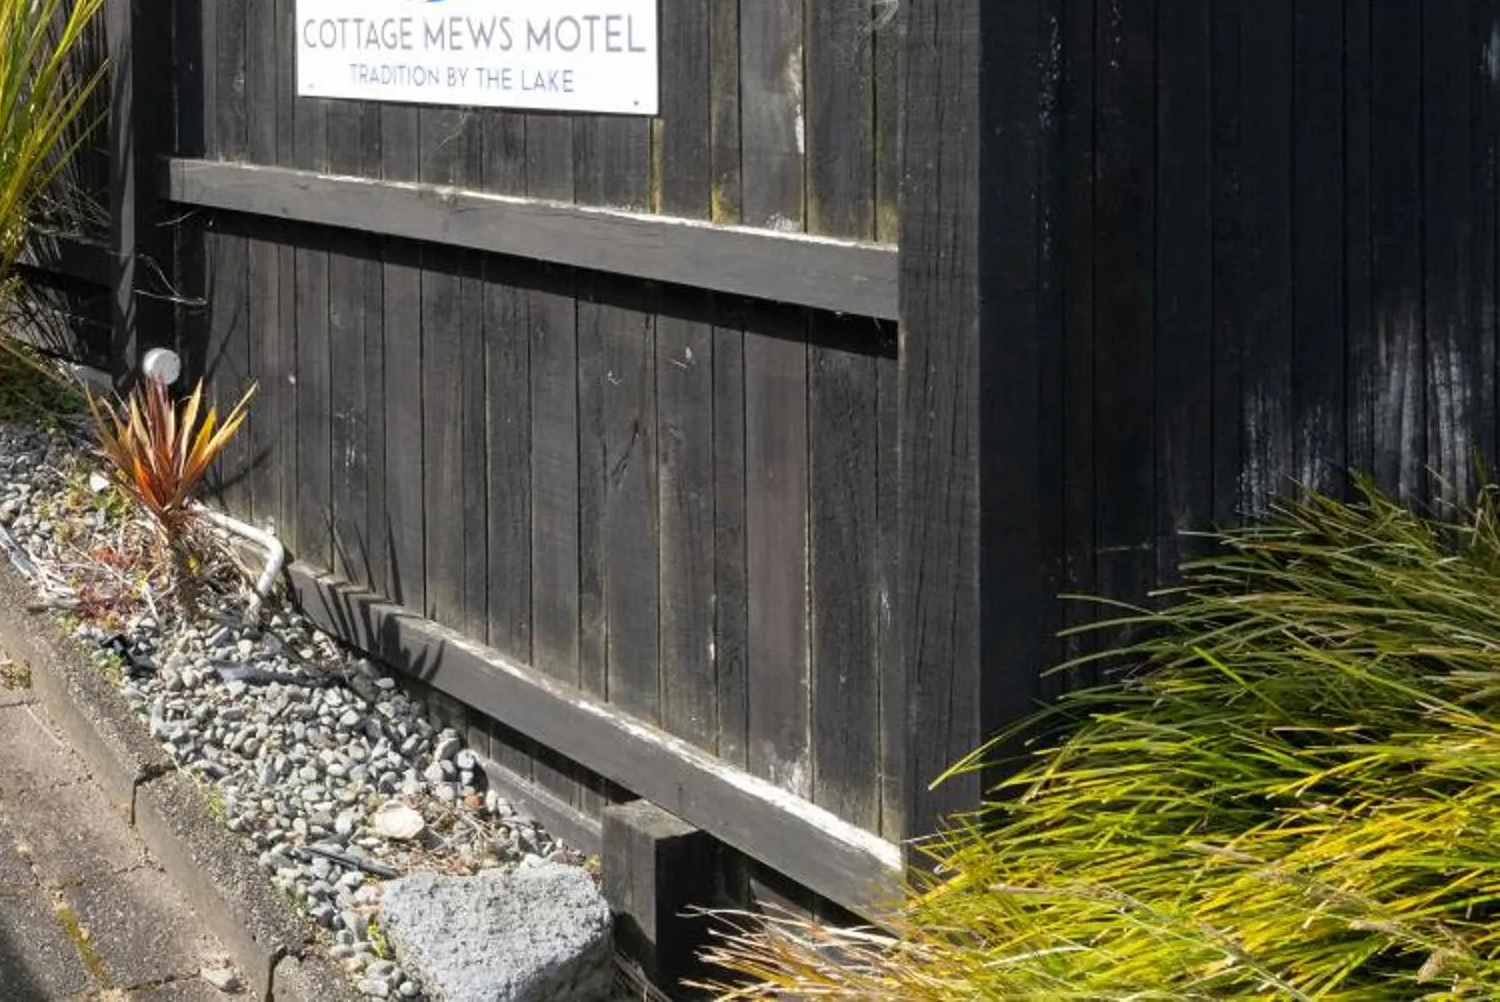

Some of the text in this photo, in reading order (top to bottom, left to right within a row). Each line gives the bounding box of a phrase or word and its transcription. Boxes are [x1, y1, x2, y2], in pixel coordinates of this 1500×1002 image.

[303, 14, 647, 53] COTTAGE MEWS MOTEL
[349, 63, 575, 93] TRADITION BY THE LAKE
